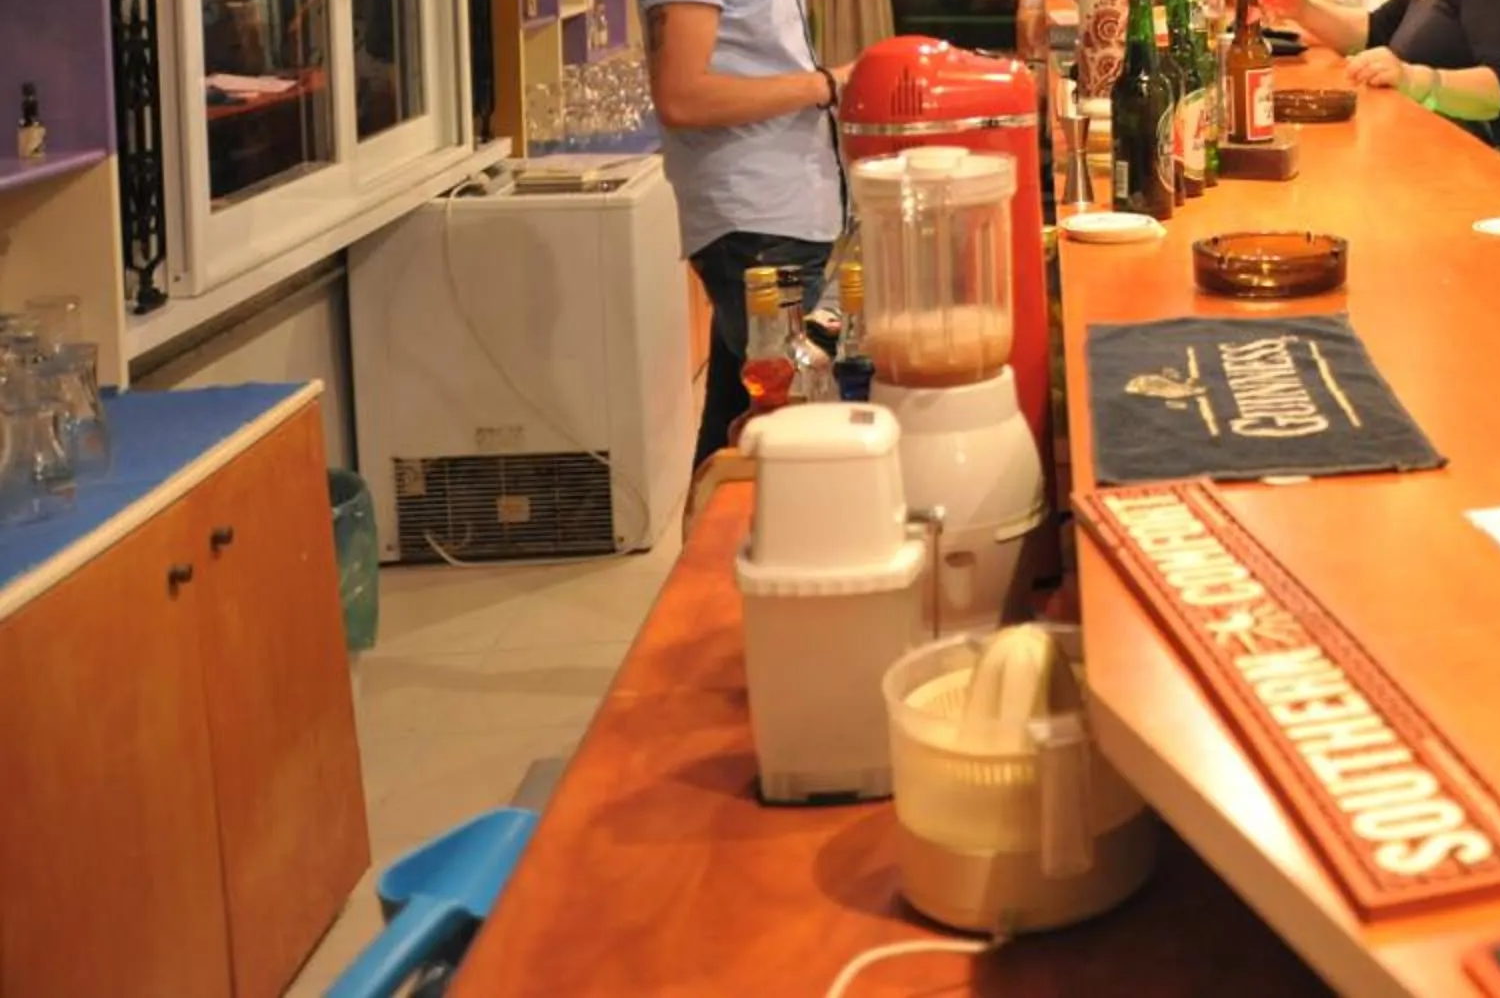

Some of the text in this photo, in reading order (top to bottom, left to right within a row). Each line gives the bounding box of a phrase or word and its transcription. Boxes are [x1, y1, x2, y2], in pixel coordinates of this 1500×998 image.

[1217, 334, 1330, 438] GUINNESS
[1102, 494, 1494, 876] SOUTHERN COMFORT
